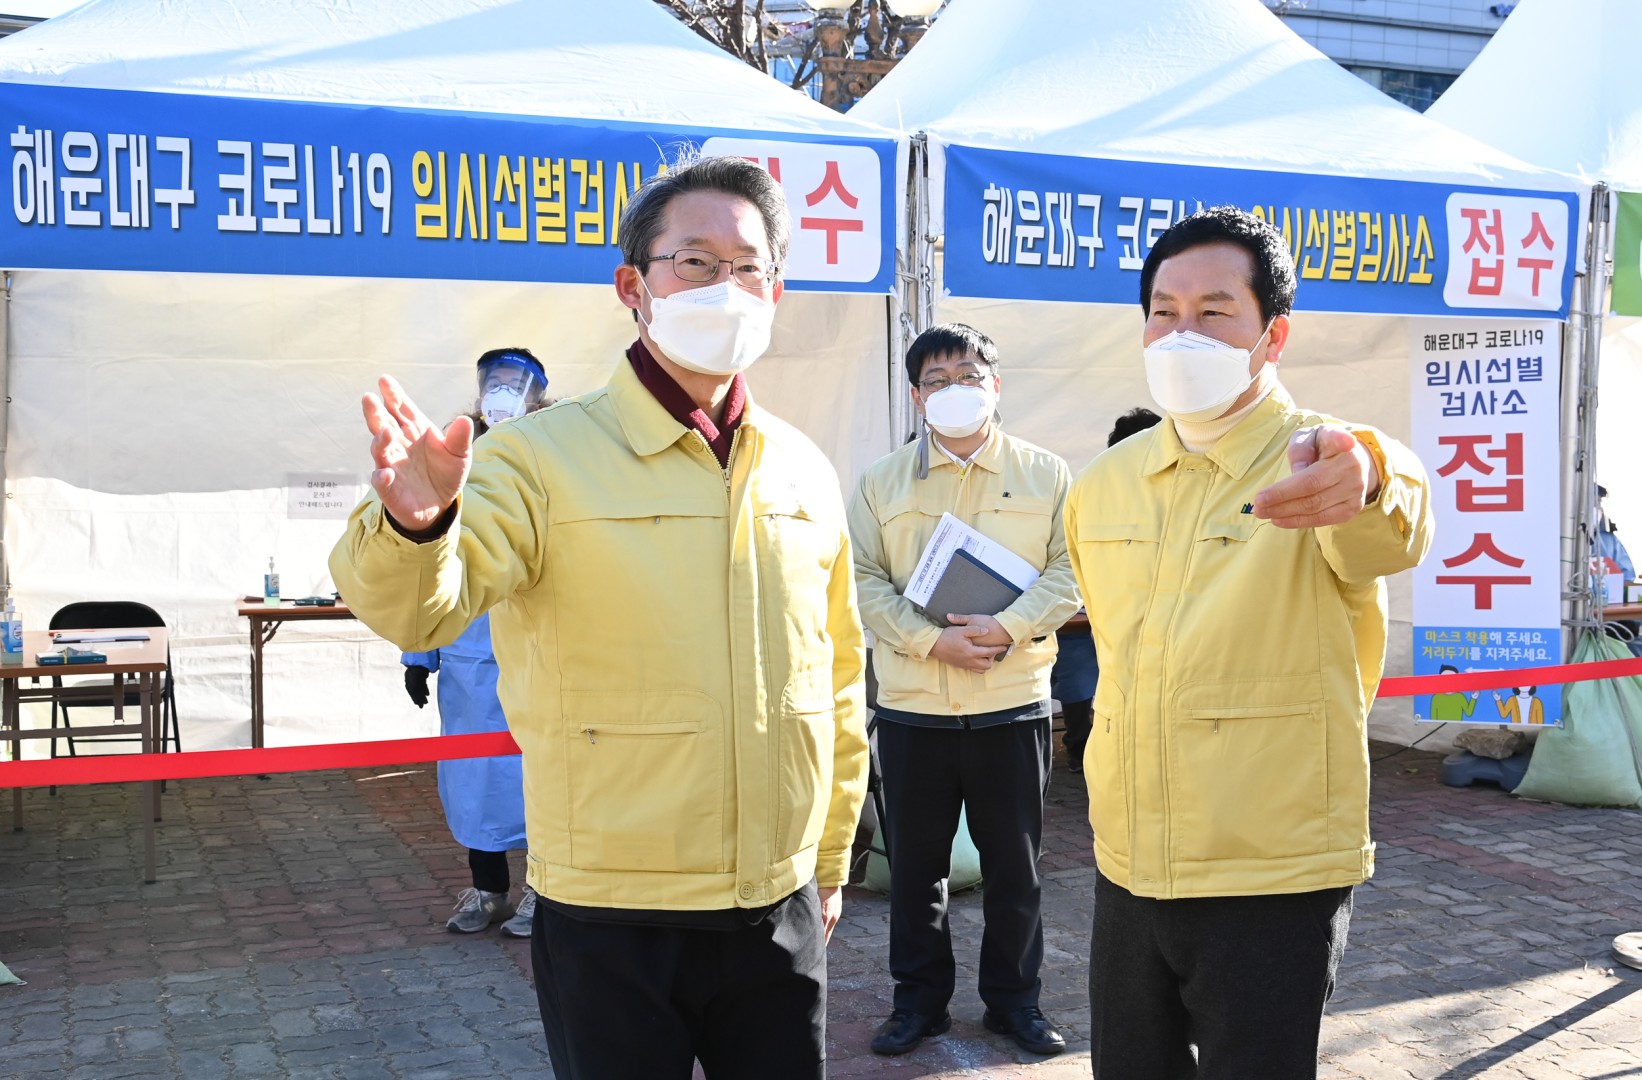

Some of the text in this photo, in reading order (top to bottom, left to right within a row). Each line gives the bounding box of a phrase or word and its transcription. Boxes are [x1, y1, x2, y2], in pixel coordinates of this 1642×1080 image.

[10, 125, 668, 245] 해운대구 코로나19 임시선별검
[741, 156, 864, 265] 수
[982, 182, 1104, 268] 해운대구
[1460, 207, 1555, 297] 접수
[1424, 329, 1544, 352] 해운대구 코로나19
[1425, 356, 1543, 387] 임시선별
[1440, 389, 1528, 417] 검사소
[1435, 432, 1532, 610] 접수
[1422, 646, 1552, 662] 거리두기를 지켜주세요.
[1425, 630, 1548, 646] 마스크 착용해 주세요.
